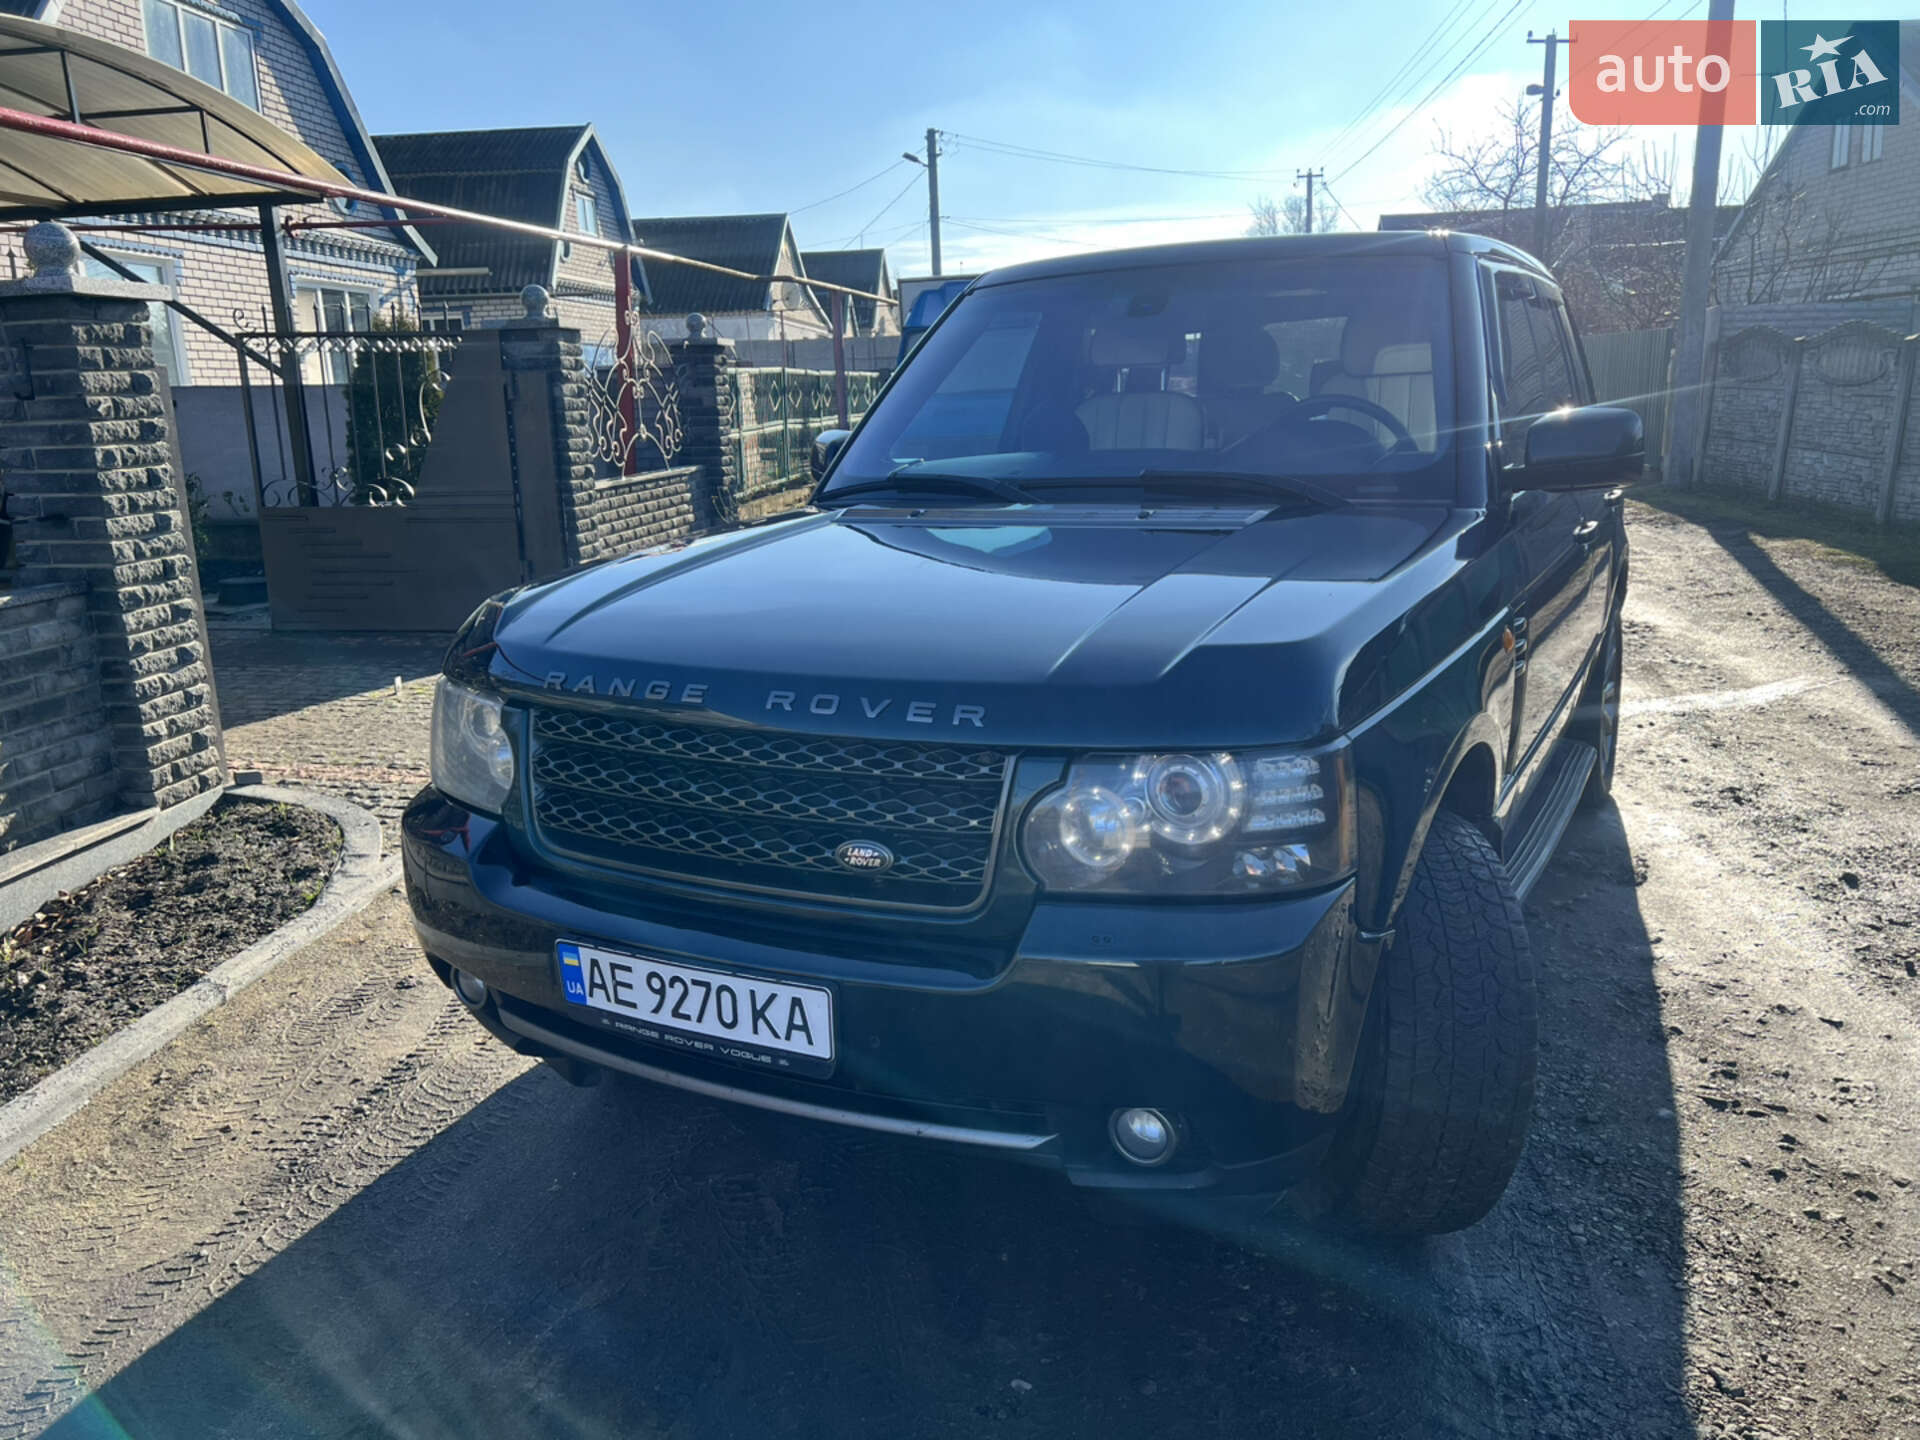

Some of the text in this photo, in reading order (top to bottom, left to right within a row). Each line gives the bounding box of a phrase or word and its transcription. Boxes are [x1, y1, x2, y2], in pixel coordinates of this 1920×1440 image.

[543, 671, 987, 728] RANGE ROVER
[847, 847, 873, 857] LAND
[849, 856, 881, 867] ROVER
[566, 980, 585, 997] UA
[588, 958, 815, 1046] AE 9270 KA
[615, 1022, 772, 1064] RANGE ROVER VOGUE
